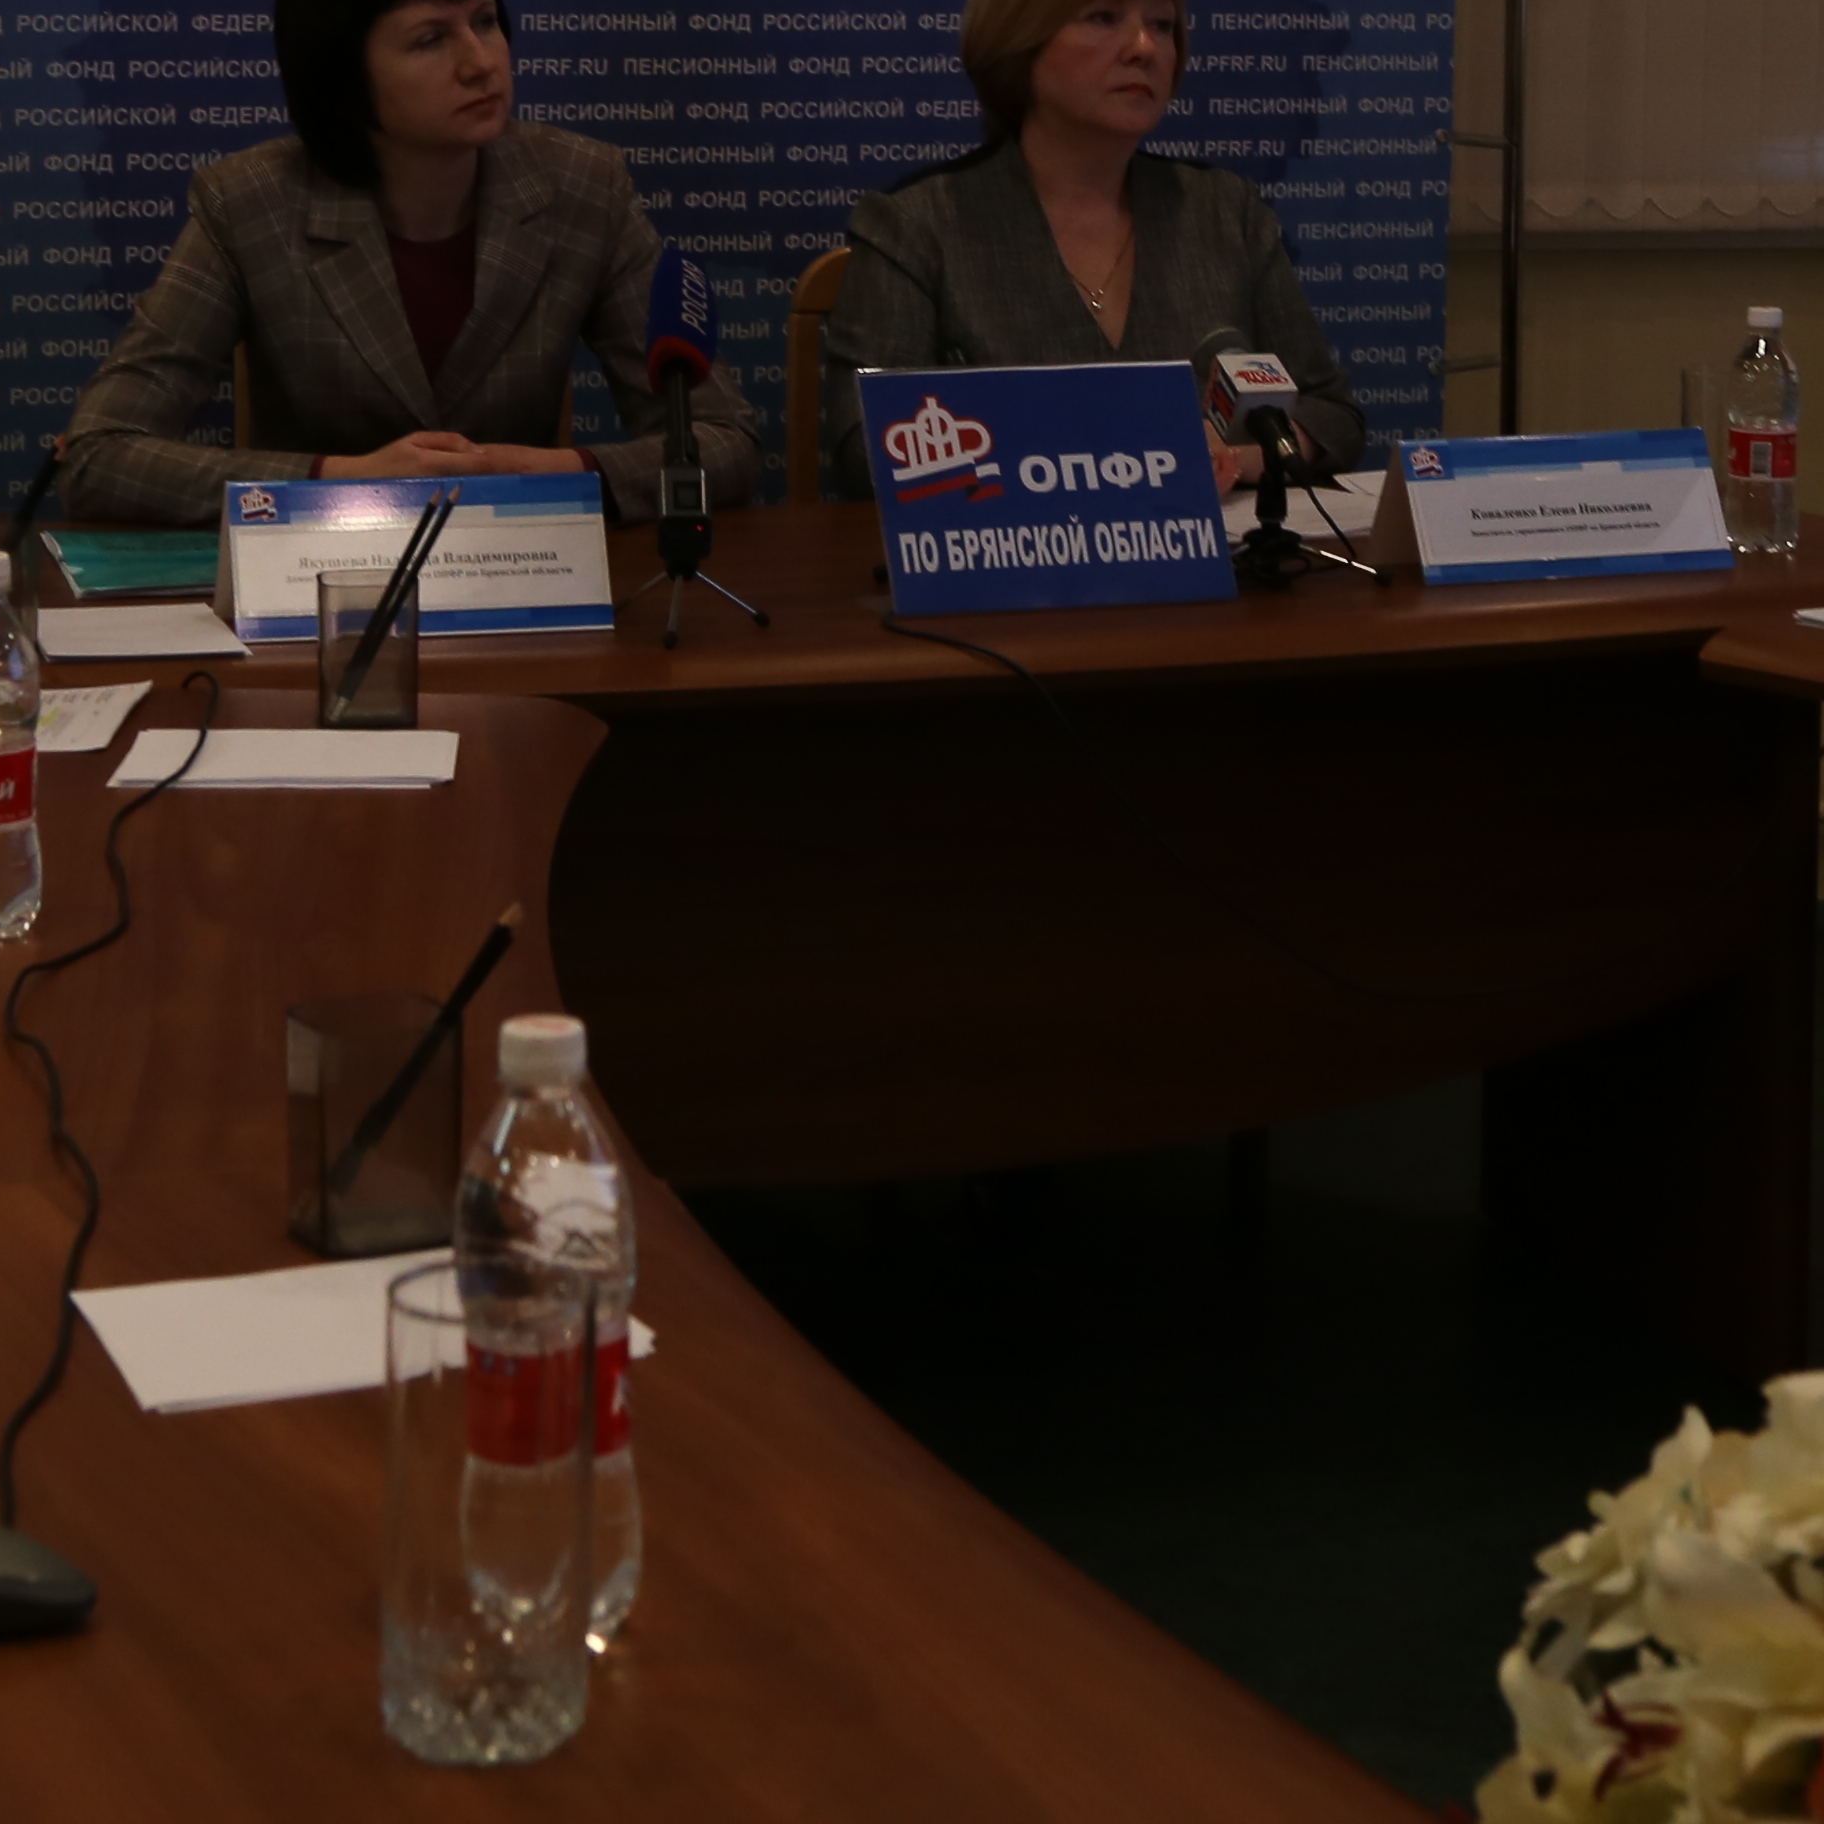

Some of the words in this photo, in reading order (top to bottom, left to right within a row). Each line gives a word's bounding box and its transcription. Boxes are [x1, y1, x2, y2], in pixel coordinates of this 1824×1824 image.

[16, 11, 180, 34] РОССИЙСКОЙ
[519, 12, 678, 33] ПЕНСИОННЫЙ
[687, 13, 753, 35] ФОНД
[761, 11, 908, 33] РОССИЙСКОЙ
[1210, 12, 1351, 32] ПЕНСИОННЫЙ
[45, 60, 117, 82] ФОНД
[622, 56, 778, 77] ПЕНСИОННЫЙ
[787, 56, 852, 77] ФОНД
[1301, 54, 1440, 73] ПЕНСИОННЫЙ
[14, 104, 178, 127] РОССИЙСКОЙ
[517, 100, 676, 122] ПЕНСИОННЫЙ
[684, 101, 751, 123] ФОНД
[759, 98, 906, 121] РОССИЙСКОЙ
[1208, 96, 1349, 116] ПЕНСИОННЫЙ
[43, 153, 115, 175] ФОНД
[785, 144, 850, 165] ФОНД
[1144, 139, 1286, 159] WWW.PFRF.RU
[1299, 137, 1439, 157] ПЕНСИОННЫЙ
[12, 199, 176, 220] РОССИЙСКОЙ
[682, 190, 748, 212] ФОНД
[42, 245, 114, 267] ФОНД
[1297, 221, 1435, 241] ПЕНСИОННЫЙ
[1352, 263, 1410, 282] ФОНД
[680, 258, 708, 336] РОССИЯ
[1019, 451, 1177, 493] ОПФР
[898, 531, 939, 574] ПО
[944, 514, 1090, 571] БРЯНСКОЙ
[1094, 518, 1220, 564] ОБЛАСТИ
